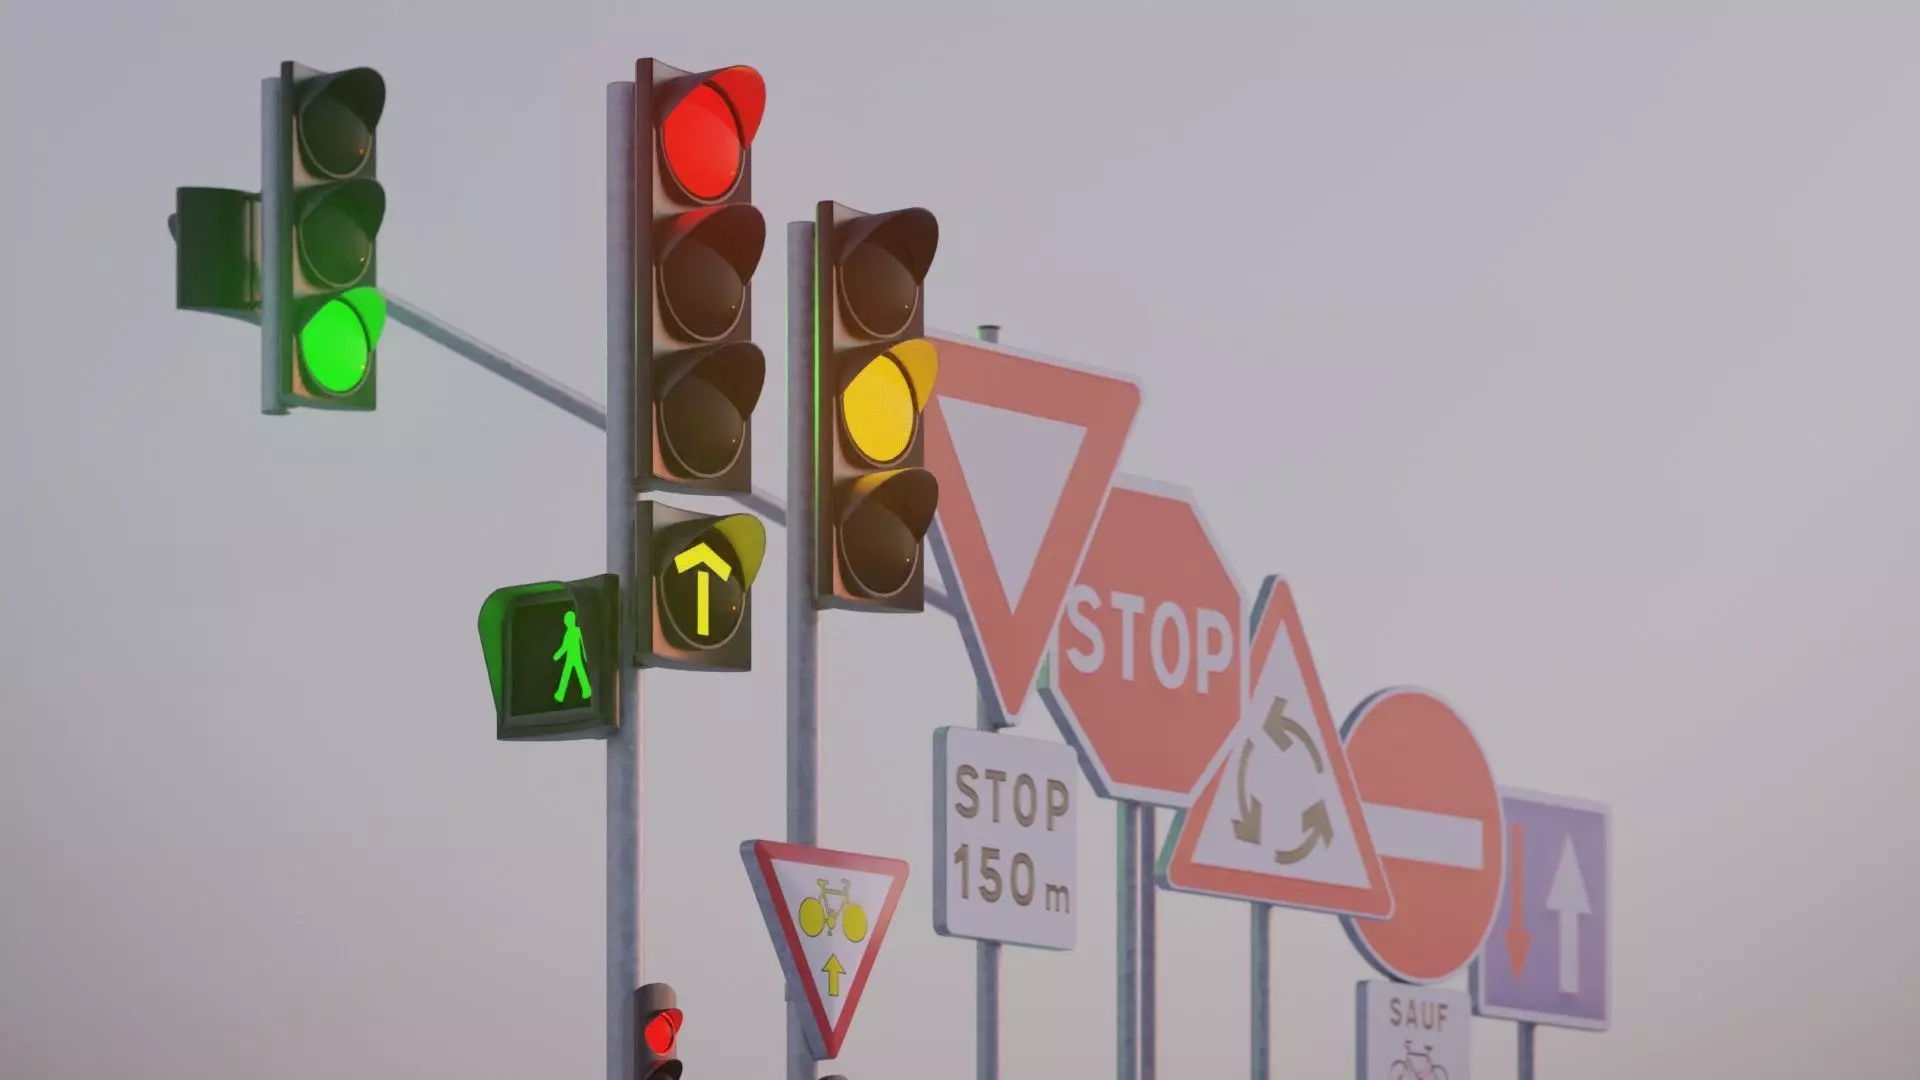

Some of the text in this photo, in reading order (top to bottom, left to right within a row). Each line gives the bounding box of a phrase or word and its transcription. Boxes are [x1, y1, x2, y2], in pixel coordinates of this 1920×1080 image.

[1066, 584, 1233, 693] STOP
[954, 764, 1070, 831] STOP
[953, 844, 1070, 914] 150 m
[1389, 997, 1449, 1032] SAUF
